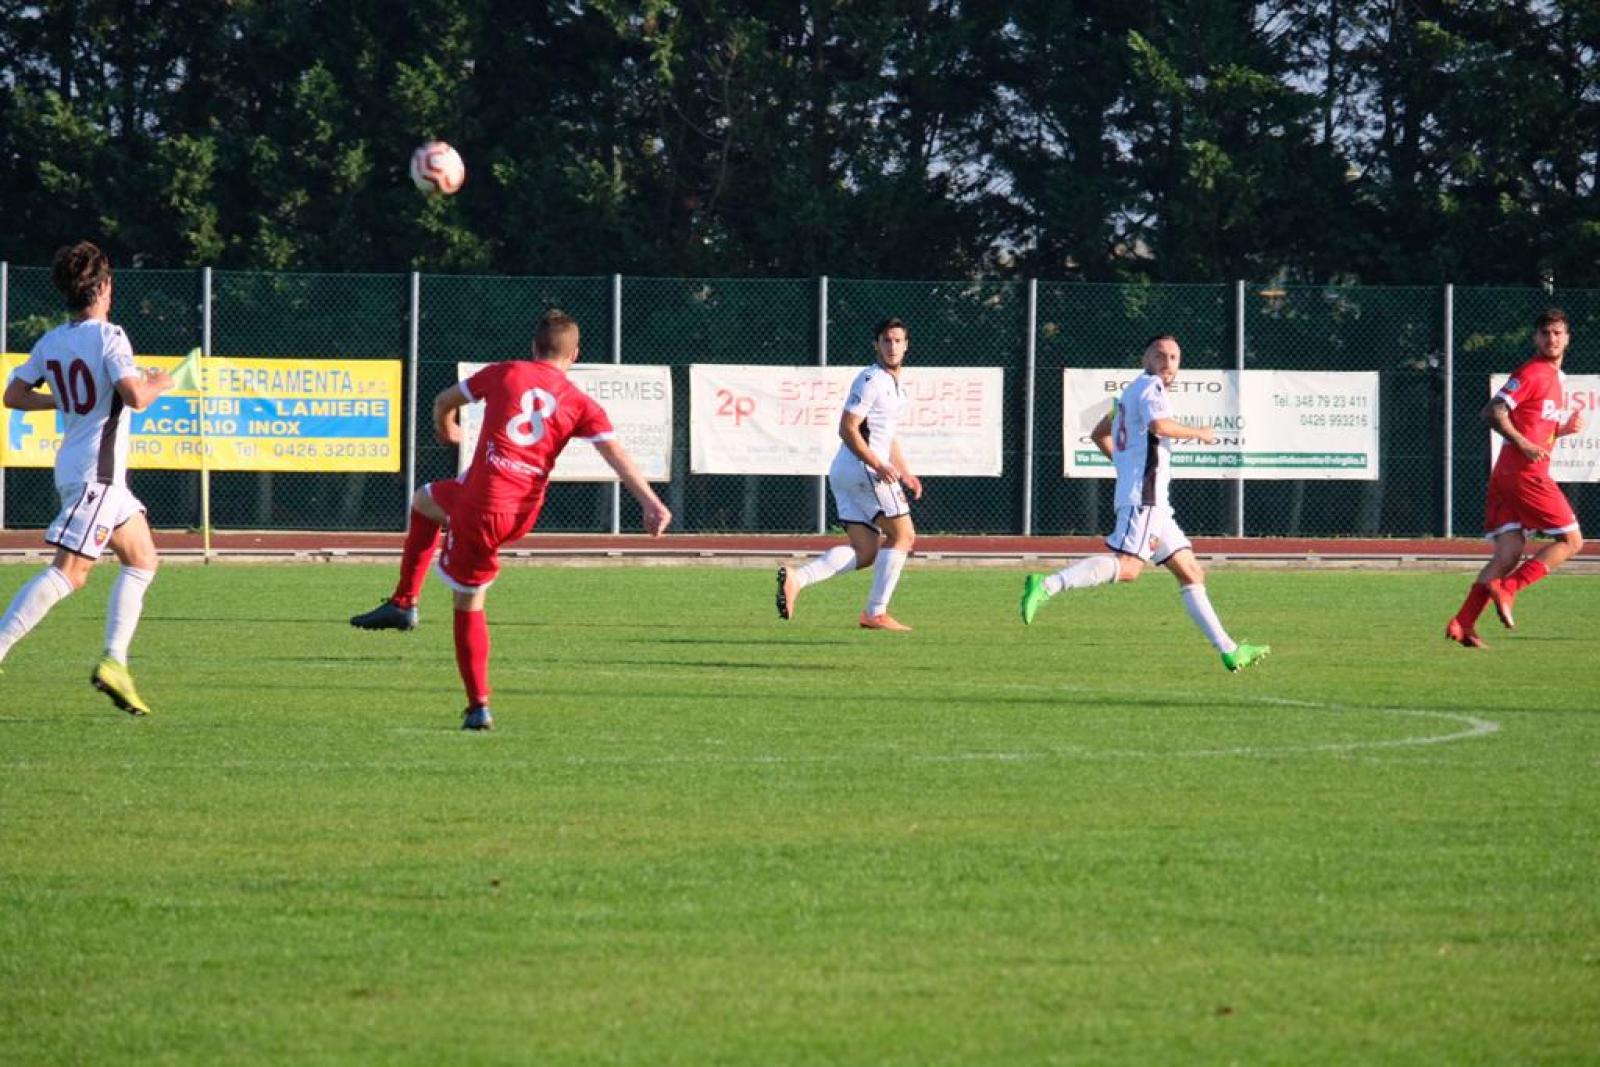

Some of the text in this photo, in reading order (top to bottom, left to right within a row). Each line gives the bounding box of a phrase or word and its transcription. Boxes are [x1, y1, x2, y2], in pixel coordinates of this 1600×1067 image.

[47, 358, 96, 416] 10
[219, 368, 353, 394] FERRAMENTA
[586, 380, 665, 401] HERMES
[186, 399, 241, 417] TUBI
[276, 400, 386, 417] LAMIERE
[506, 388, 557, 447] 8
[141, 418, 301, 436] ACCIAIO INOX
